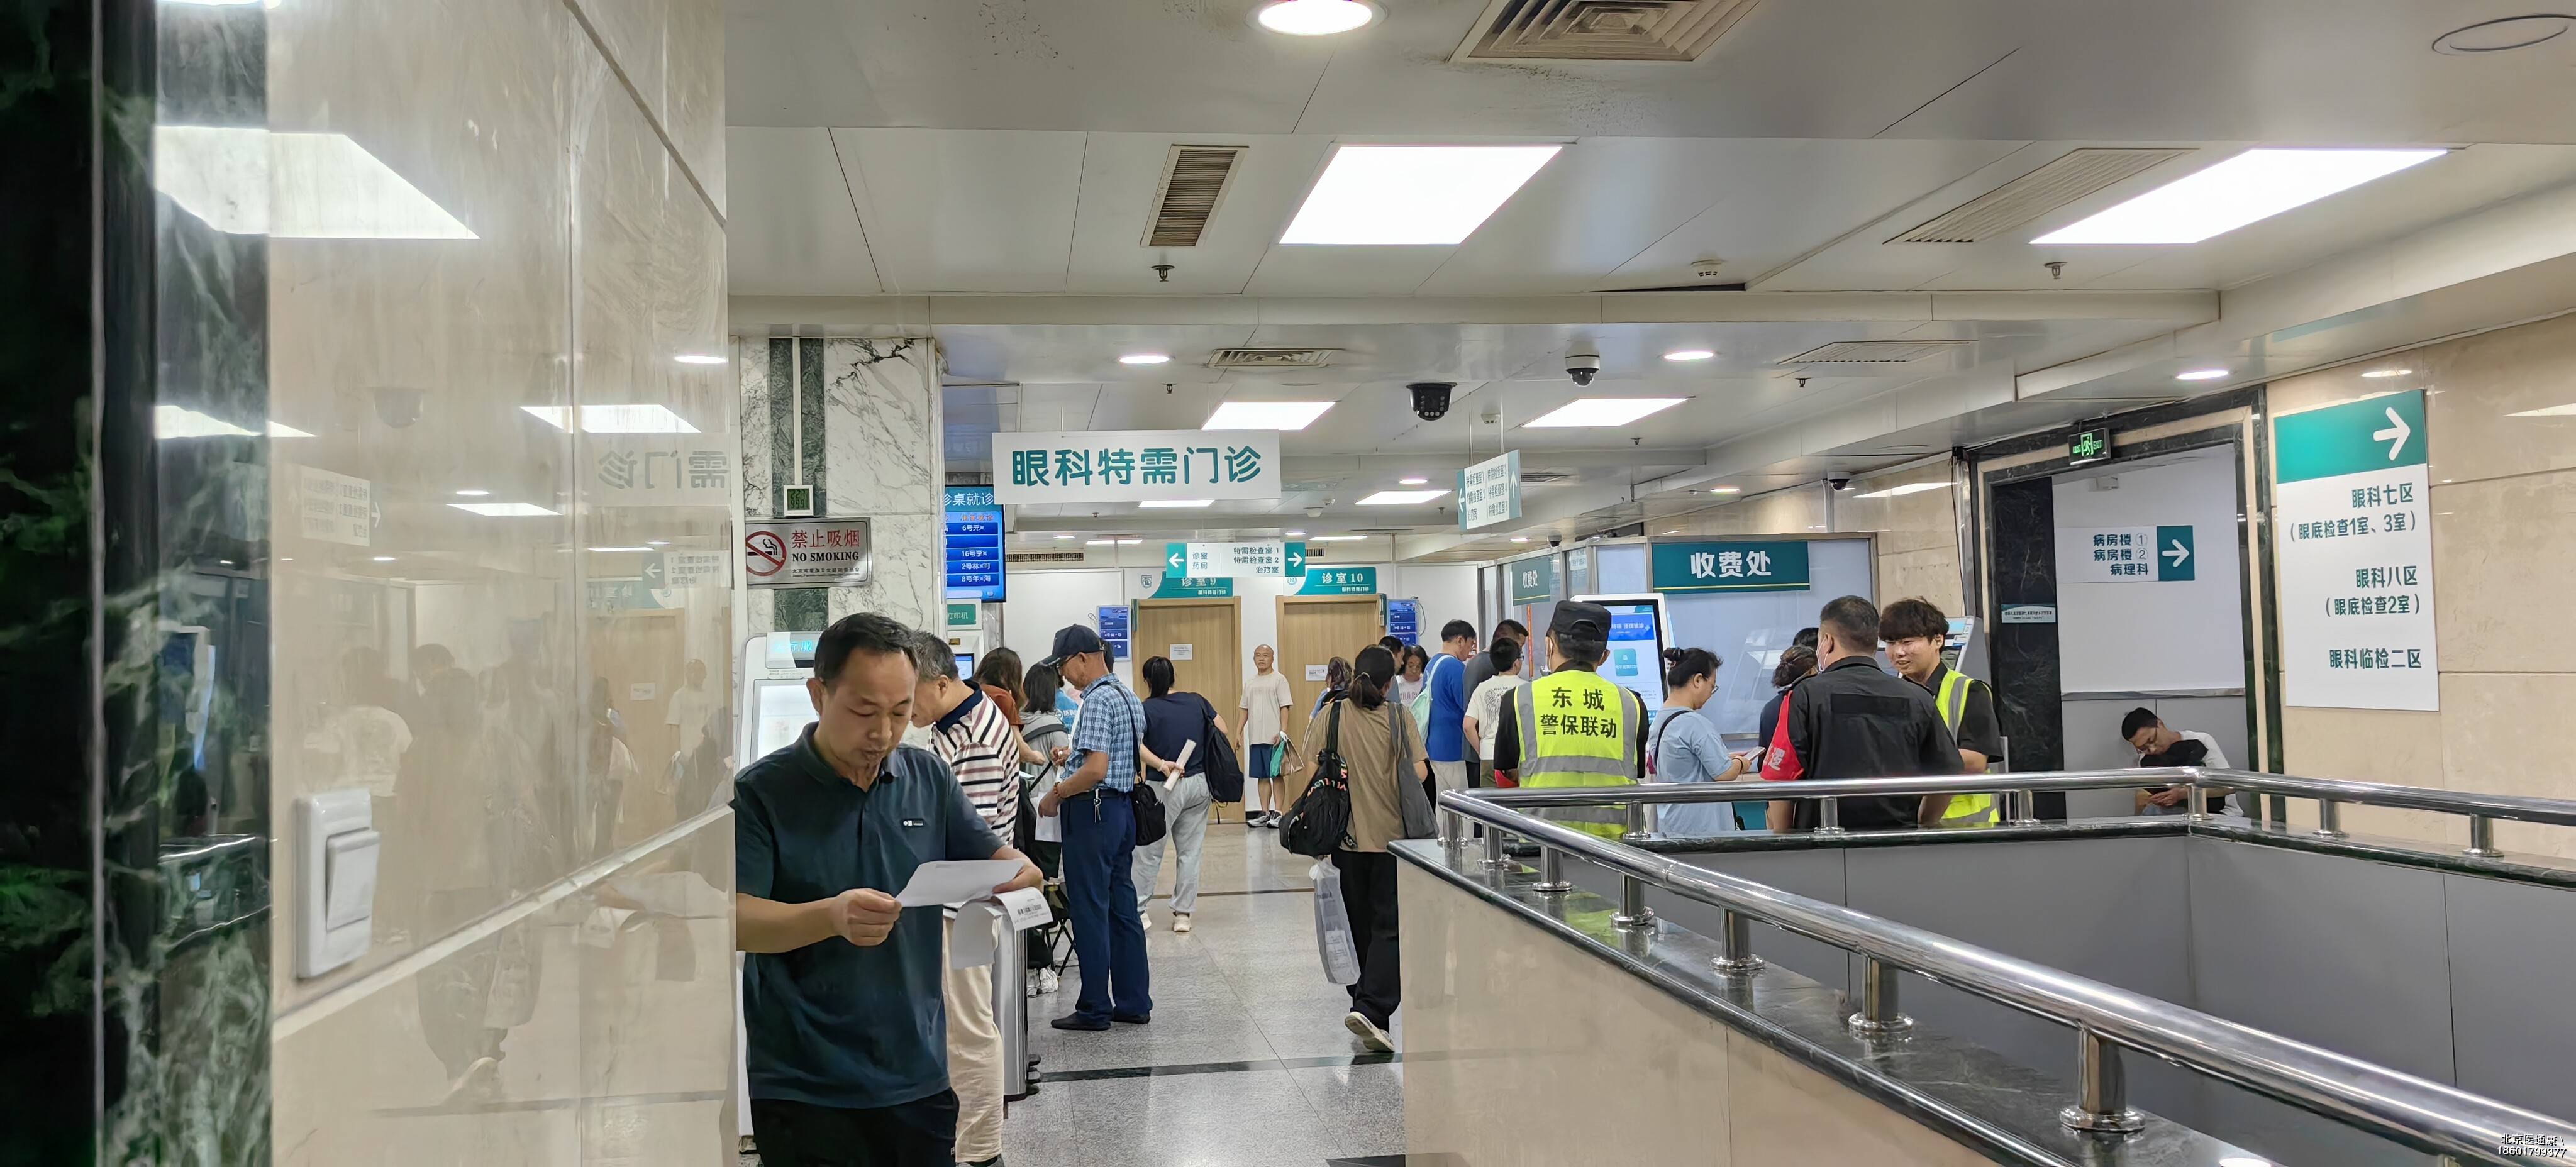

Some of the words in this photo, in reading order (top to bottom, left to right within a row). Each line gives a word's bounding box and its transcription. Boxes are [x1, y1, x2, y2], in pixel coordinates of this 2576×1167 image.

[1012, 446, 1262, 487] 眼科特需门诊
[2352, 483, 2413, 508] 眼科七区
[791, 529, 860, 548] 禁止吸烟
[792, 553, 807, 561] NO
[810, 552, 859, 561] SMOKING
[1690, 551, 1772, 578] 收费处
[1322, 573, 1363, 584] 诊室10
[2110, 563, 2148, 575] 病理科
[2355, 566, 2418, 589] 眼科八区
[2329, 648, 2422, 669] 眼科临检二区
[1551, 687, 1605, 711] 东城
[1540, 714, 1617, 738] 警保联动
